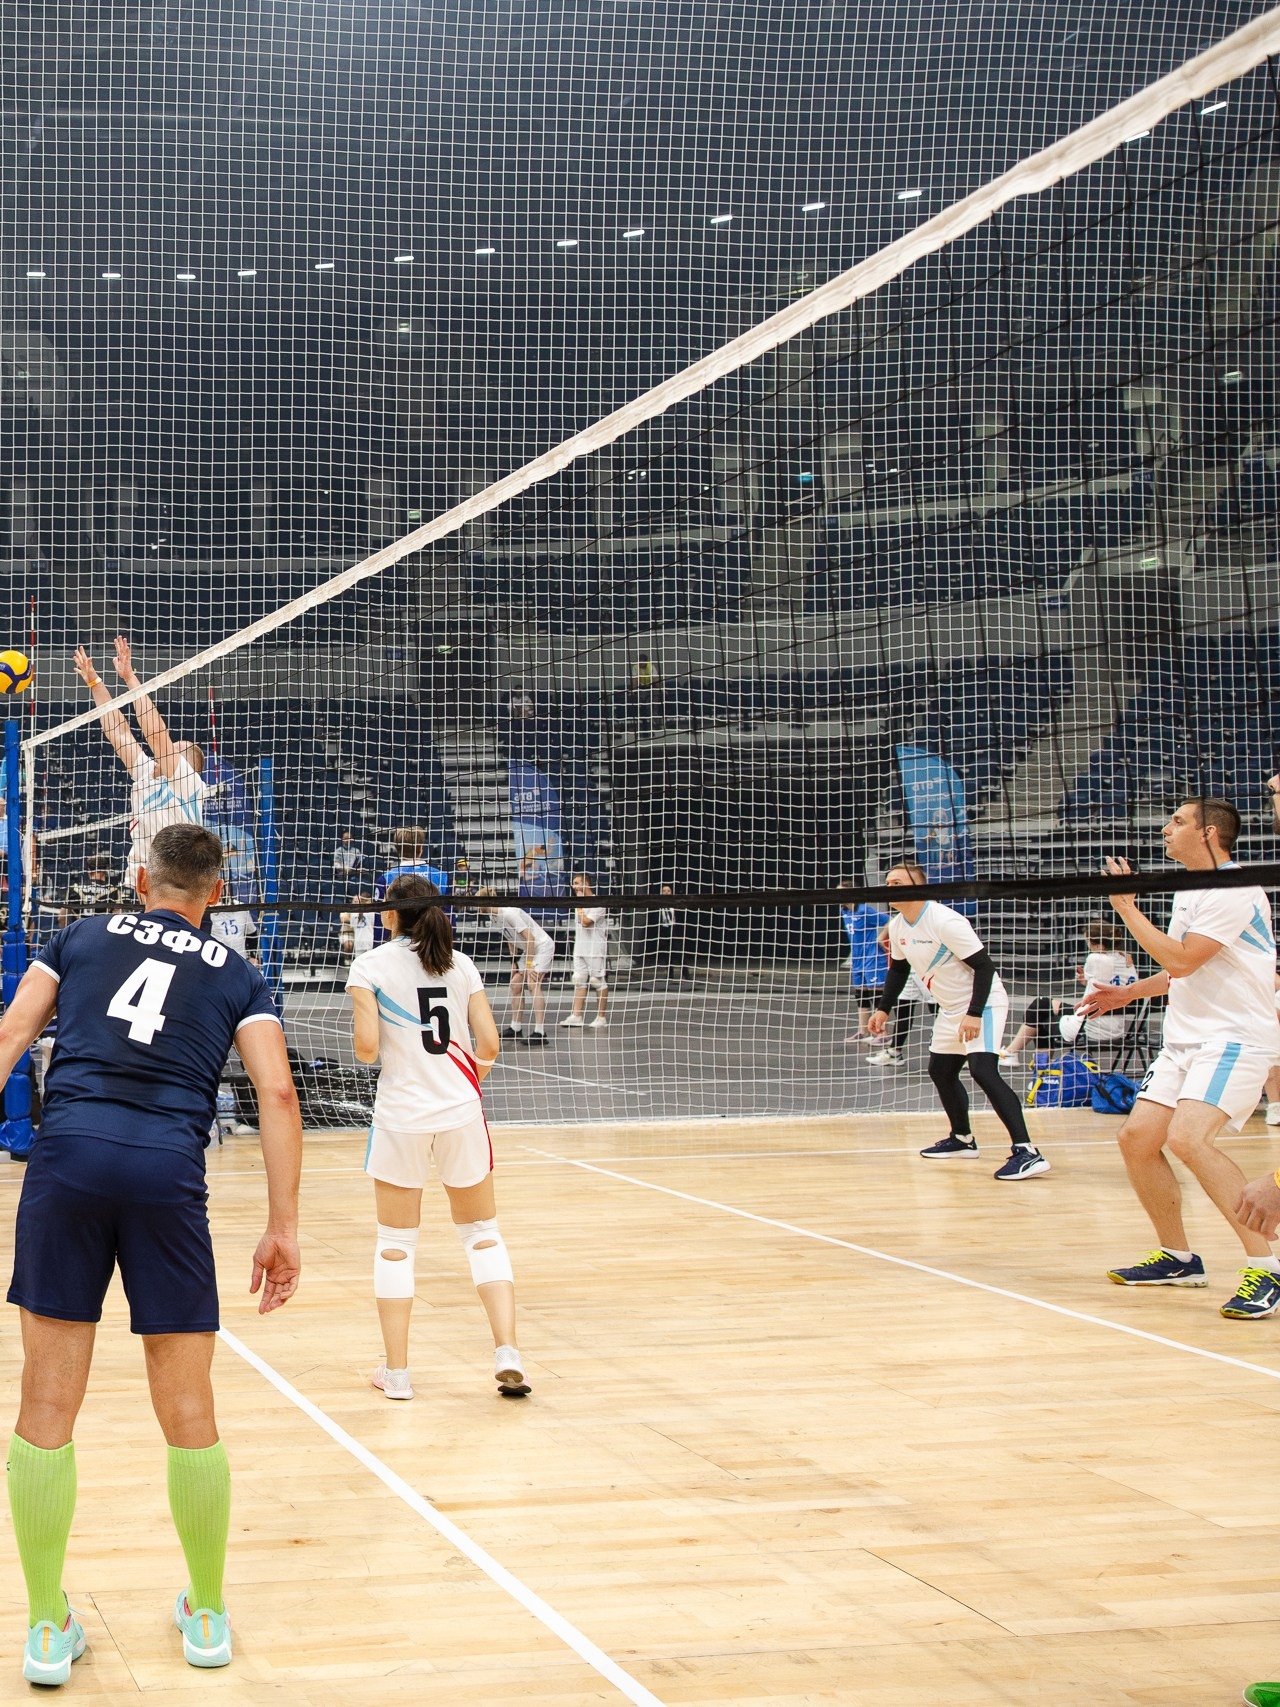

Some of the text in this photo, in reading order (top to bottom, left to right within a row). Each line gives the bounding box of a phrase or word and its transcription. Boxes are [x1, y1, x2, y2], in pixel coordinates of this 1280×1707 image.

[107, 914, 228, 968] СЗФО
[221, 920, 239, 935] 15
[106, 957, 177, 1045] 4
[416, 986, 451, 1055] 5
